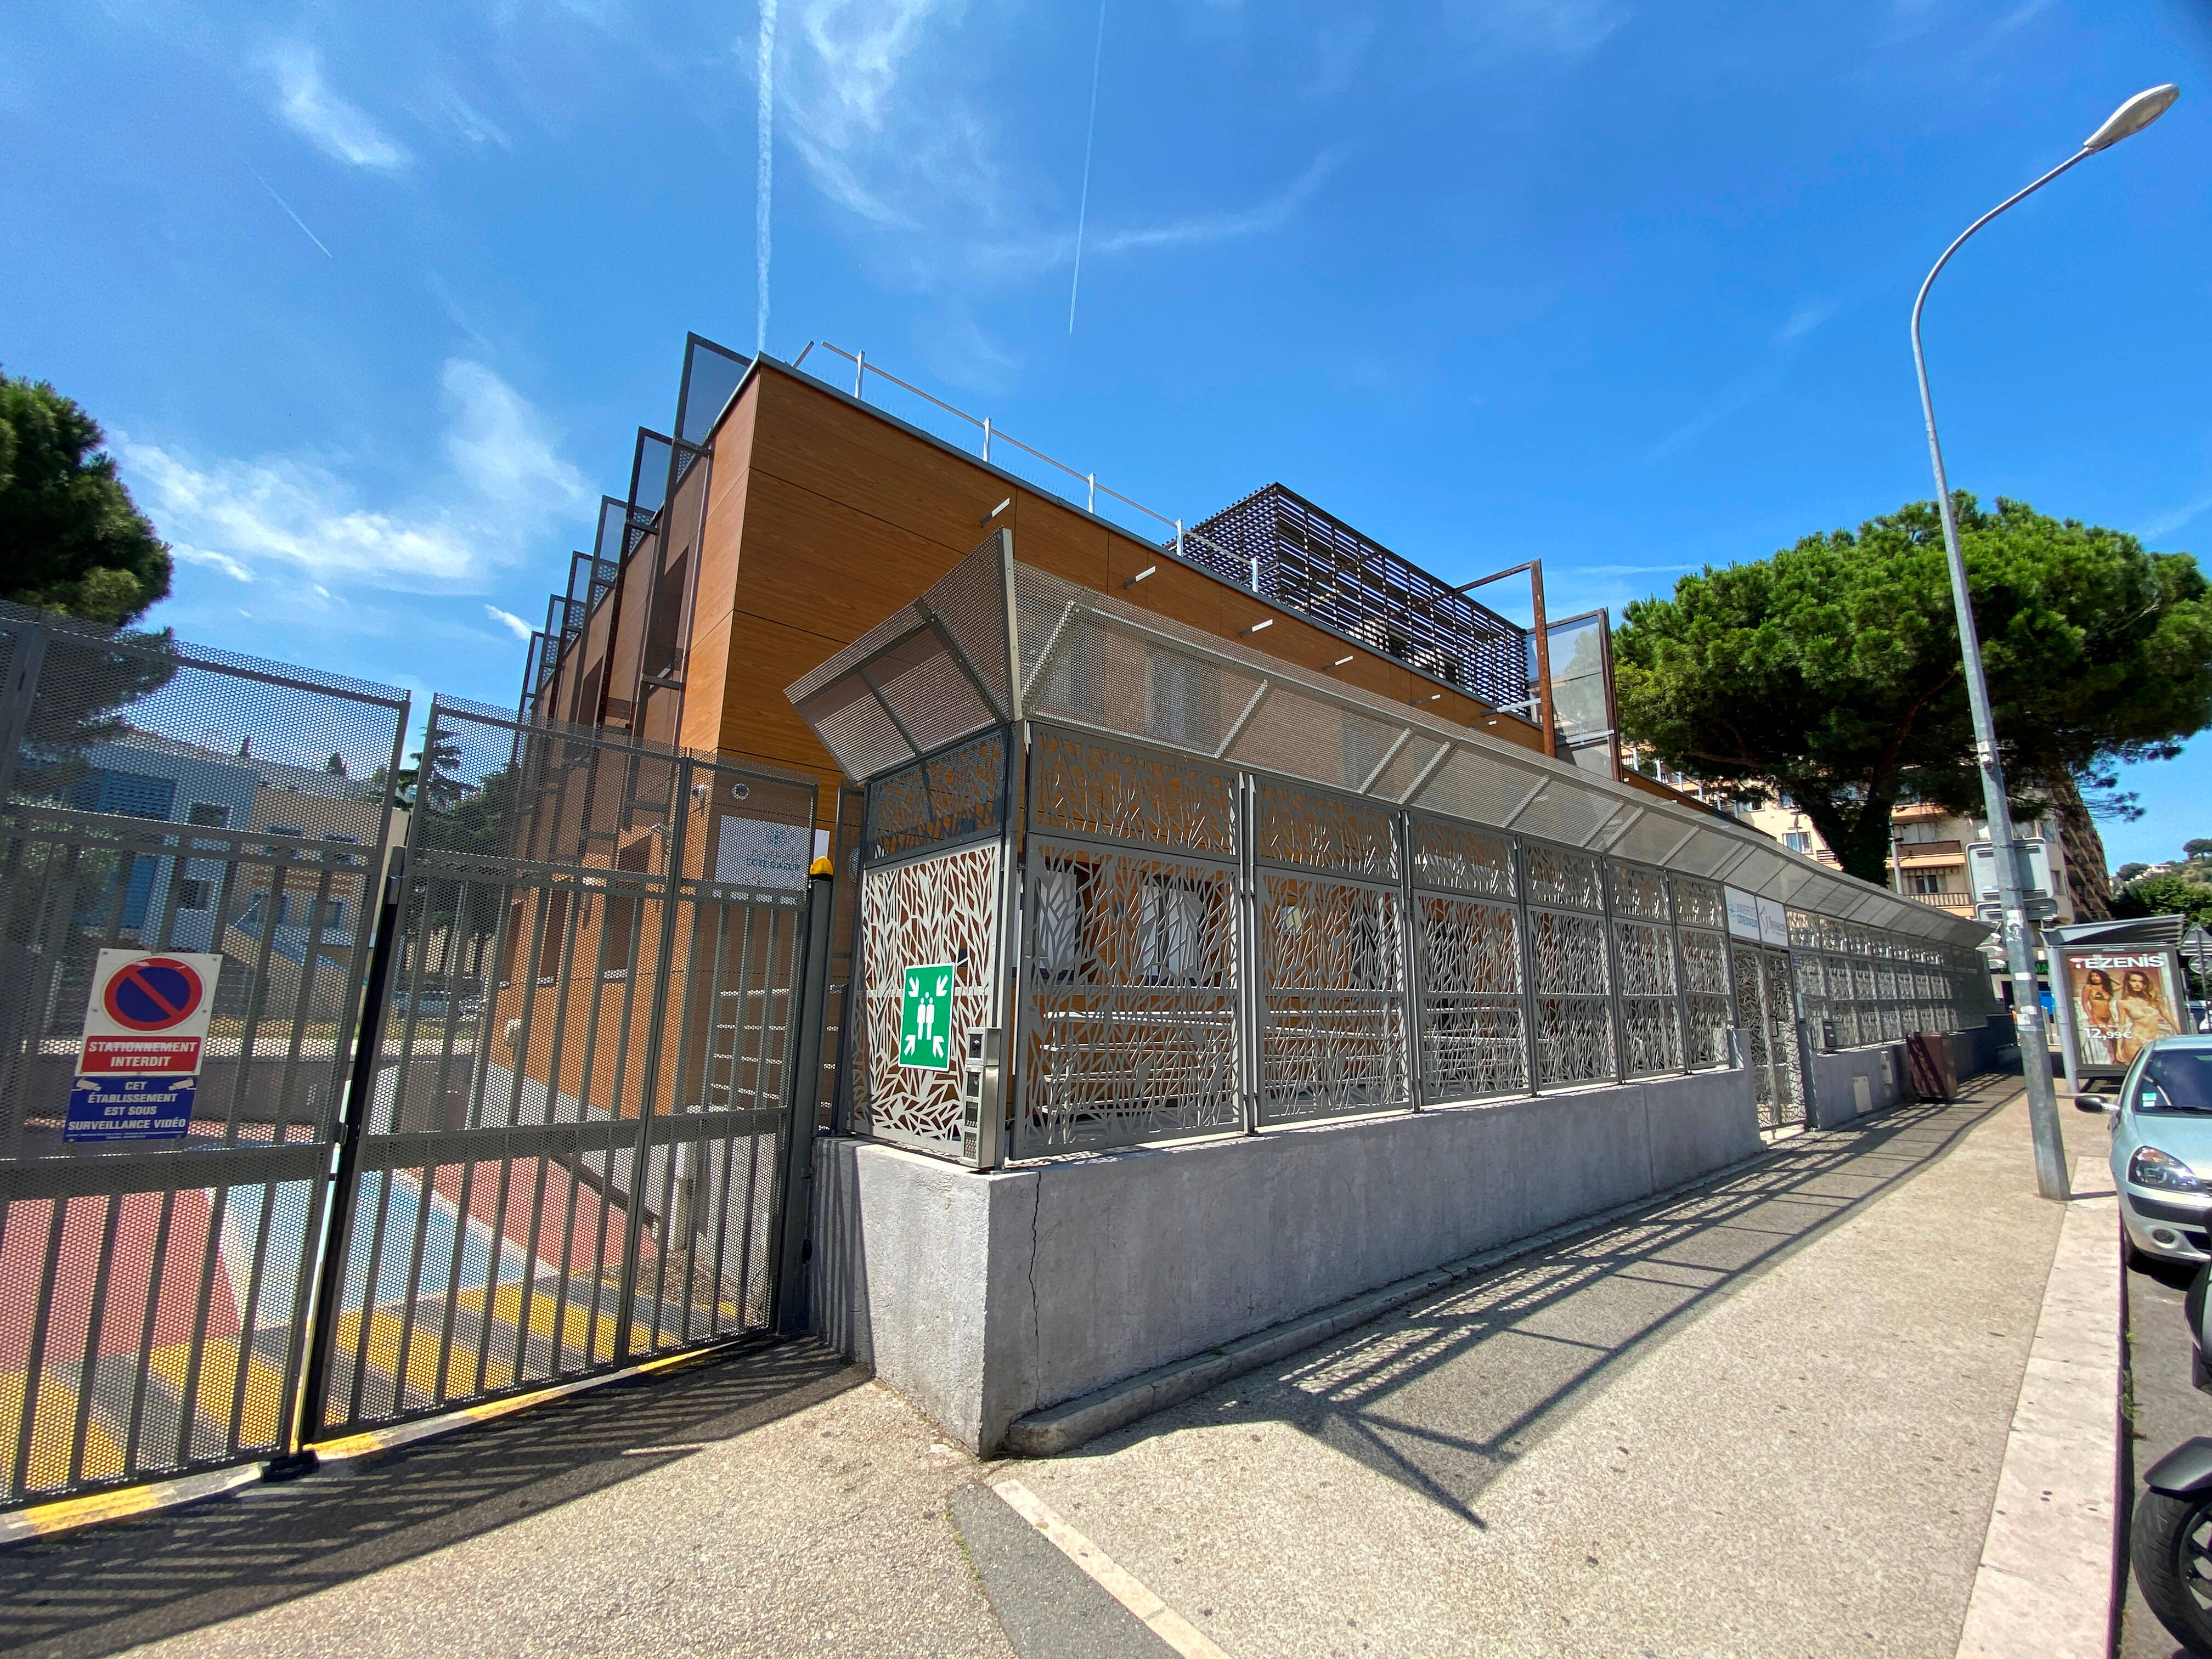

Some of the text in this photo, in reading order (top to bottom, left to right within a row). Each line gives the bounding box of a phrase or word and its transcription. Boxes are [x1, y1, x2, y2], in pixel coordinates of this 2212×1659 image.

[88, 1041, 198, 1052] STATIONNEMENT
[110, 1056, 171, 1067] INTERDIT
[125, 1081, 148, 1091] CET
[88, 1092, 178, 1104] ÉTABLISSEMENT
[104, 1105, 157, 1116] EST SOUS
[68, 1116, 186, 1130] SURVEILLANCE VIDÉO
